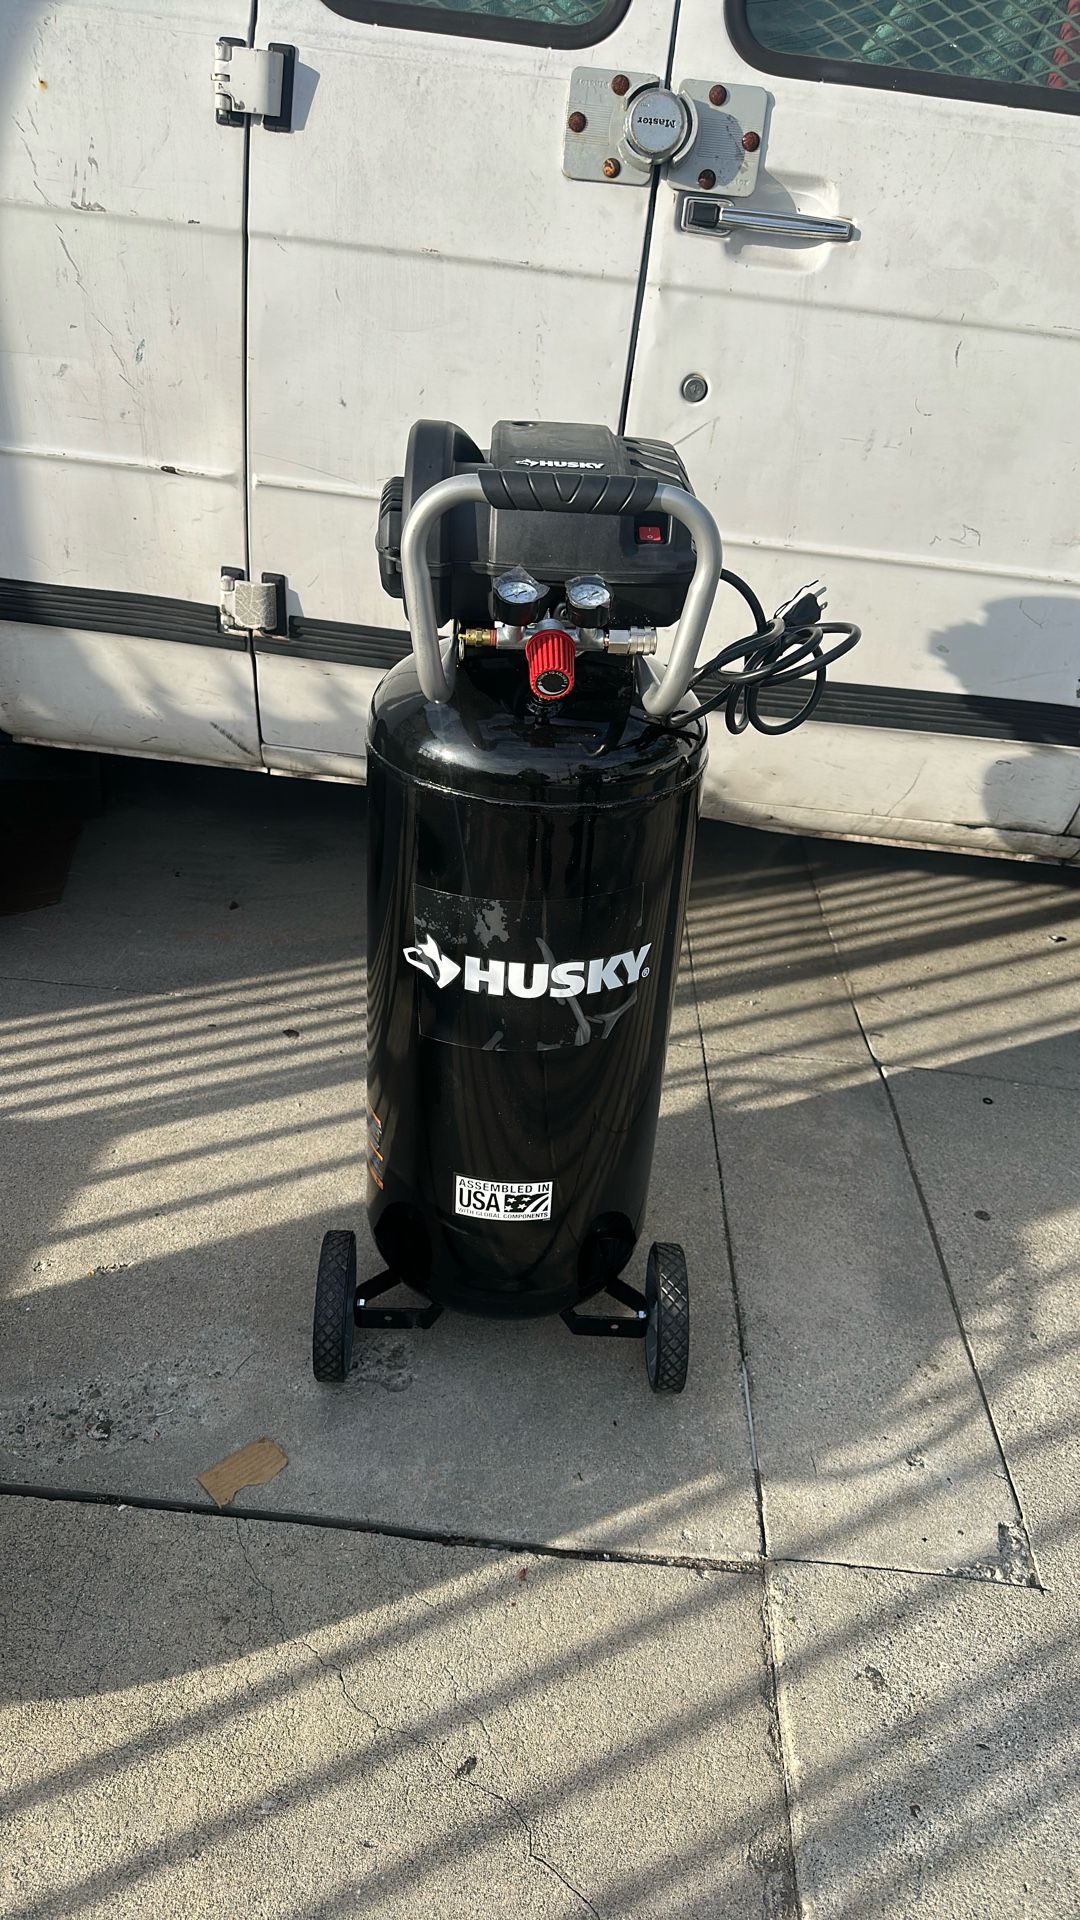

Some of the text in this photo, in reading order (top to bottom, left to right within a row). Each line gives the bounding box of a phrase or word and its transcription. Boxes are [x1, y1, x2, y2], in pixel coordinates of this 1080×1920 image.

[637, 117, 676, 128] Master
[540, 460, 605, 470] HUSKY
[464, 942, 651, 999] HUSKY
[459, 1178, 550, 1193] ASSEMBLED IN
[459, 1188, 500, 1212] USA
[458, 1207, 474, 1215] WITH
[476, 1210, 500, 1218] GLOBAL
